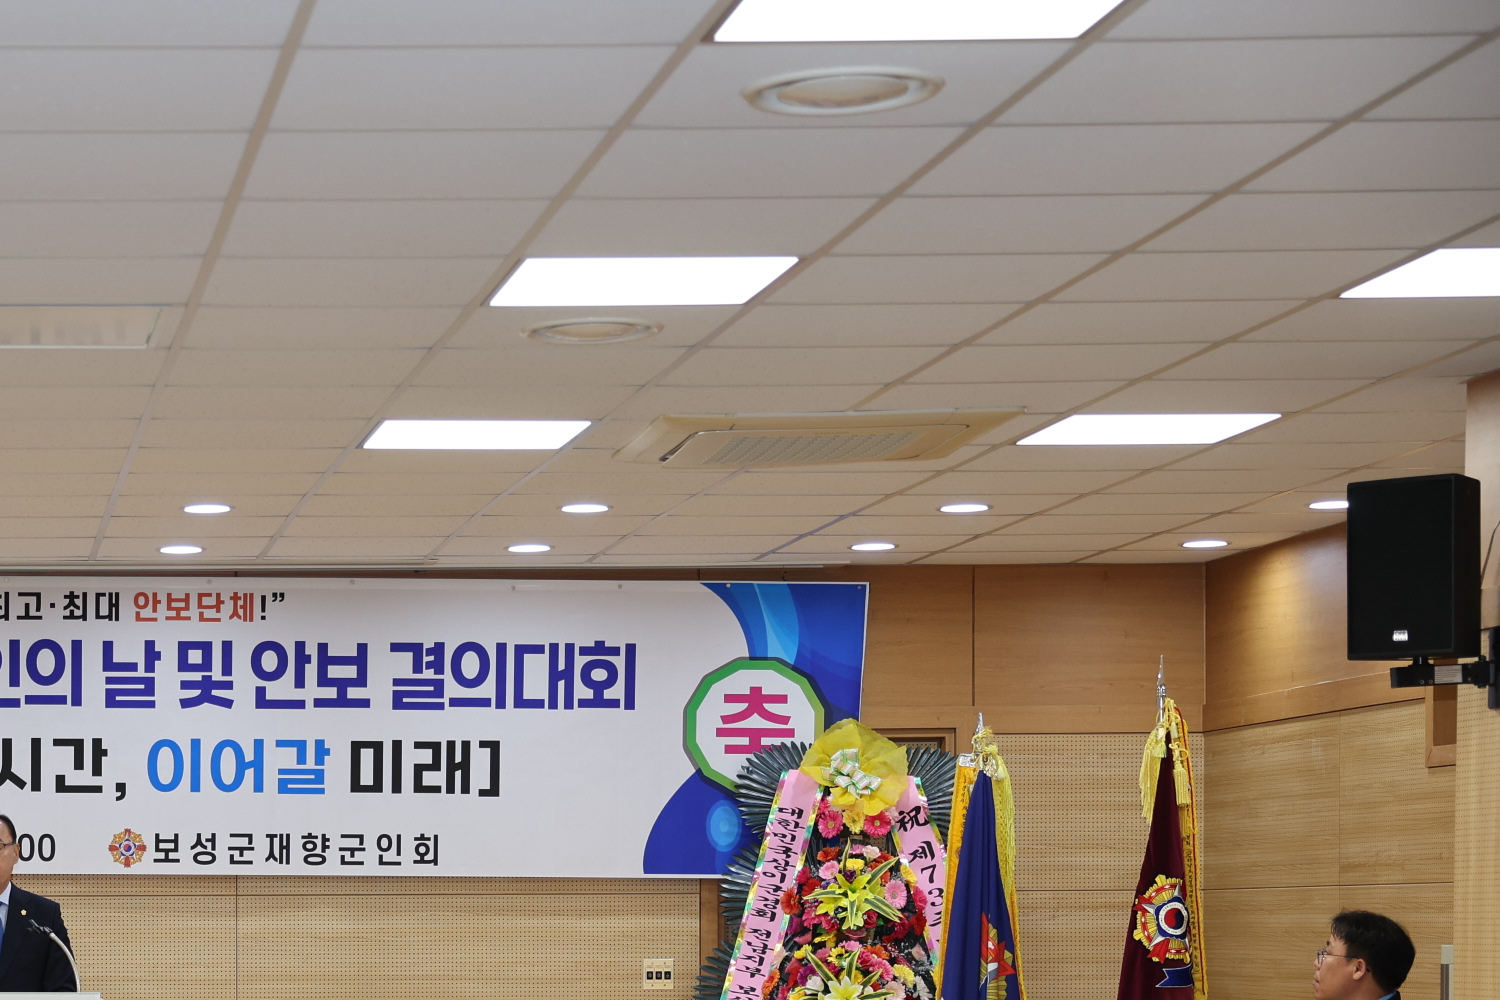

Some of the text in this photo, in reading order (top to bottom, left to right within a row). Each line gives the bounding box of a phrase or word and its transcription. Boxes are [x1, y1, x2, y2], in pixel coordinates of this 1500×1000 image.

[133, 591, 286, 622] 안보단체!”
[102, 640, 162, 709] 날
[177, 640, 235, 710] 및
[250, 640, 371, 710] 안보
[389, 640, 637, 711] 결의대회
[716, 686, 795, 755] 축
[147, 739, 331, 794] 이어갈
[350, 740, 501, 798] 미래]
[895, 805, 930, 832] 祝
[153, 833, 439, 866] 보성군재향군인회
[735, 927, 775, 979] 전남지부
